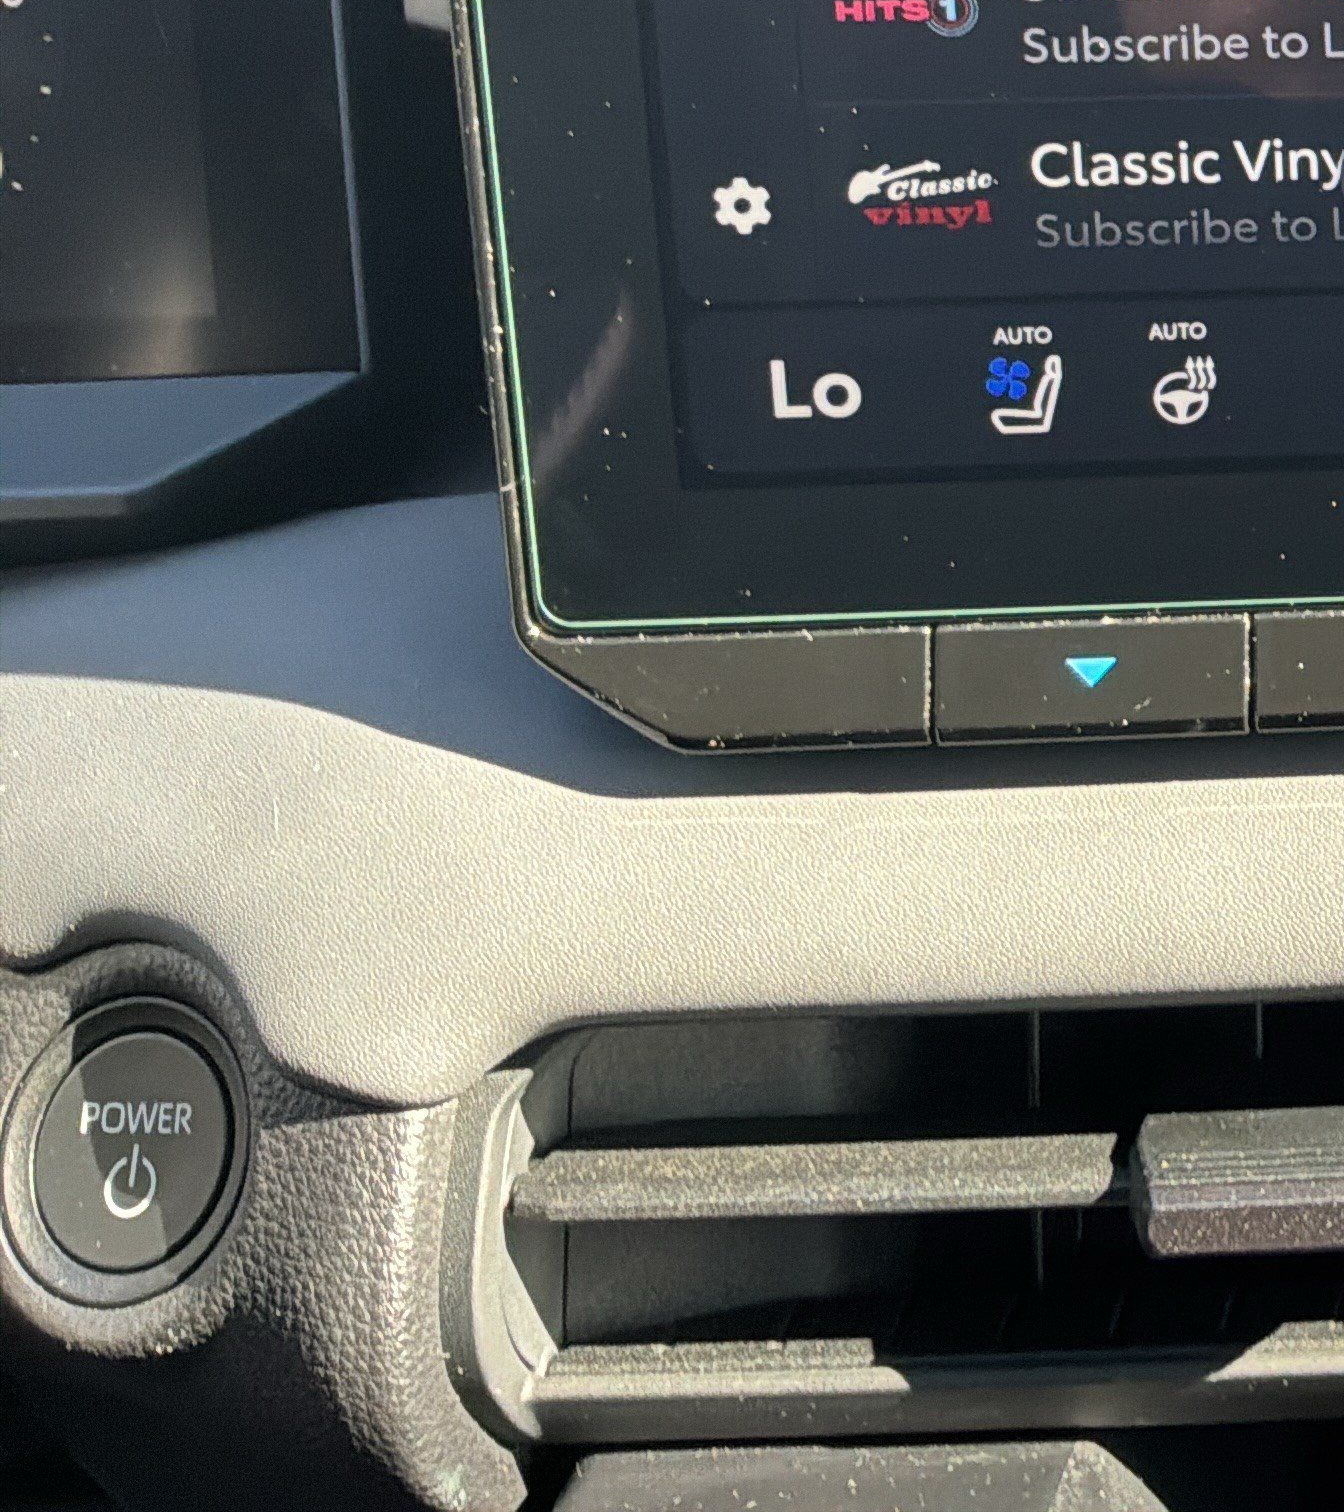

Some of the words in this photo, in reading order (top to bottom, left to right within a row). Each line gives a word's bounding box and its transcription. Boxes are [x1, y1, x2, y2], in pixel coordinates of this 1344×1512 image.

[1023, 23, 1250, 64] Subscribe
[1261, 26, 1309, 60] to
[1030, 140, 1222, 188] Classic
[887, 169, 993, 201] Classic
[863, 198, 993, 230] vinyl
[1035, 207, 1259, 248] Subscribe
[1270, 209, 1318, 243] to
[992, 325, 1053, 346] AUTO
[1148, 321, 1208, 341] AUTO
[769, 359, 862, 419] Lo
[79, 1101, 192, 1135] POWER
